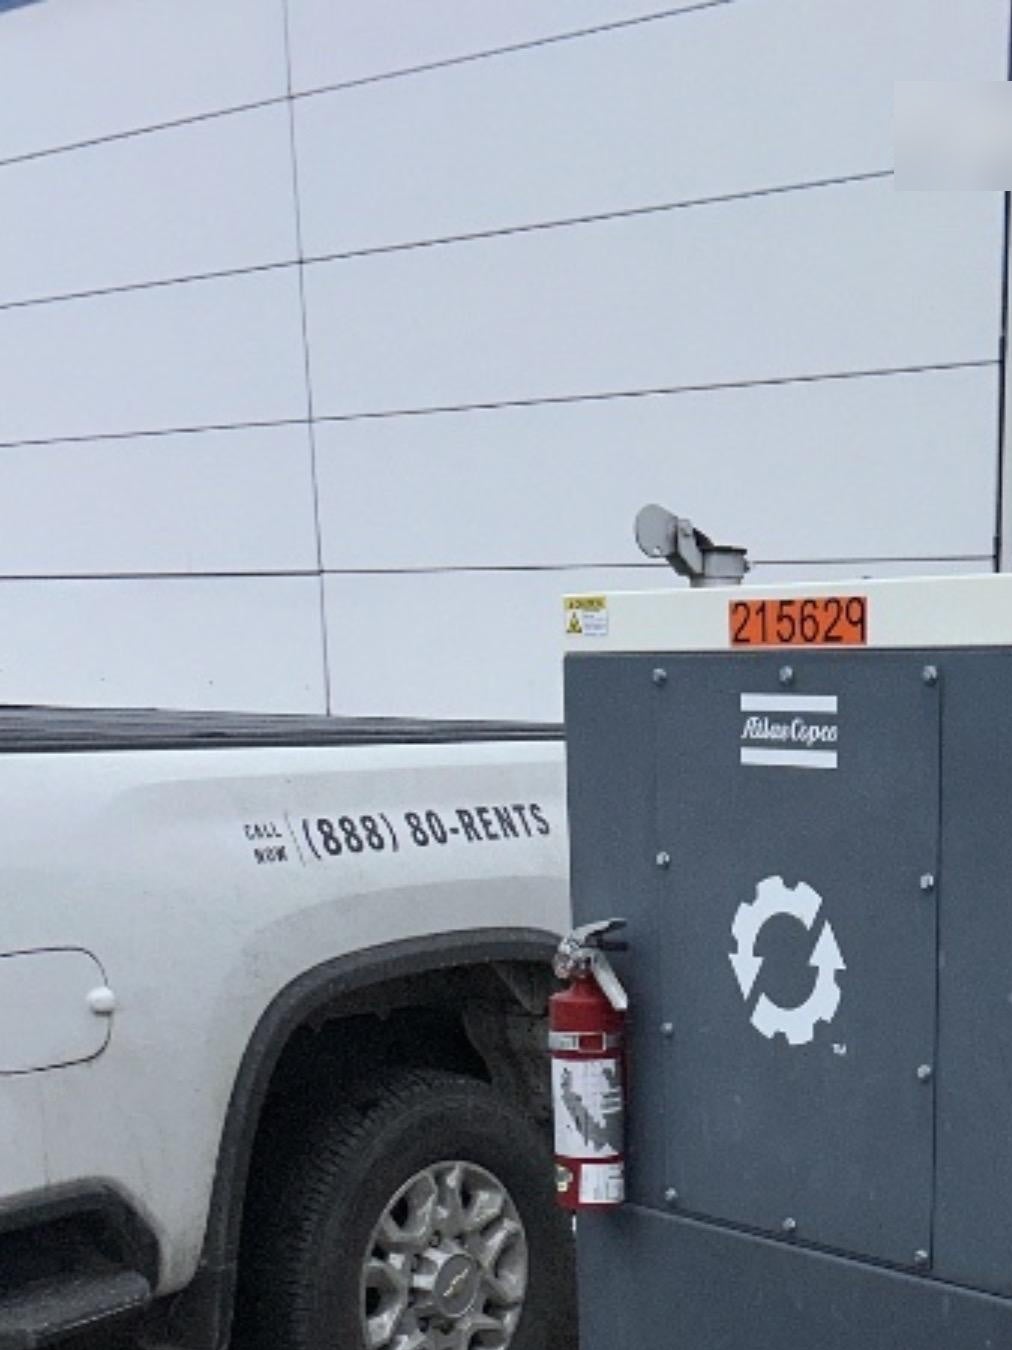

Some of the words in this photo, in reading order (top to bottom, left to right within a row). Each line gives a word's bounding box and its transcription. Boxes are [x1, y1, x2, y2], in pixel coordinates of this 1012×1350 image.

[731, 597, 866, 644] 215629
[740, 716, 789, 741] Atlas
[790, 717, 838, 746] Copco
[244, 822, 283, 841] CALL
[302, 812, 400, 862] (888)
[404, 802, 551, 848] 80-RENTS
